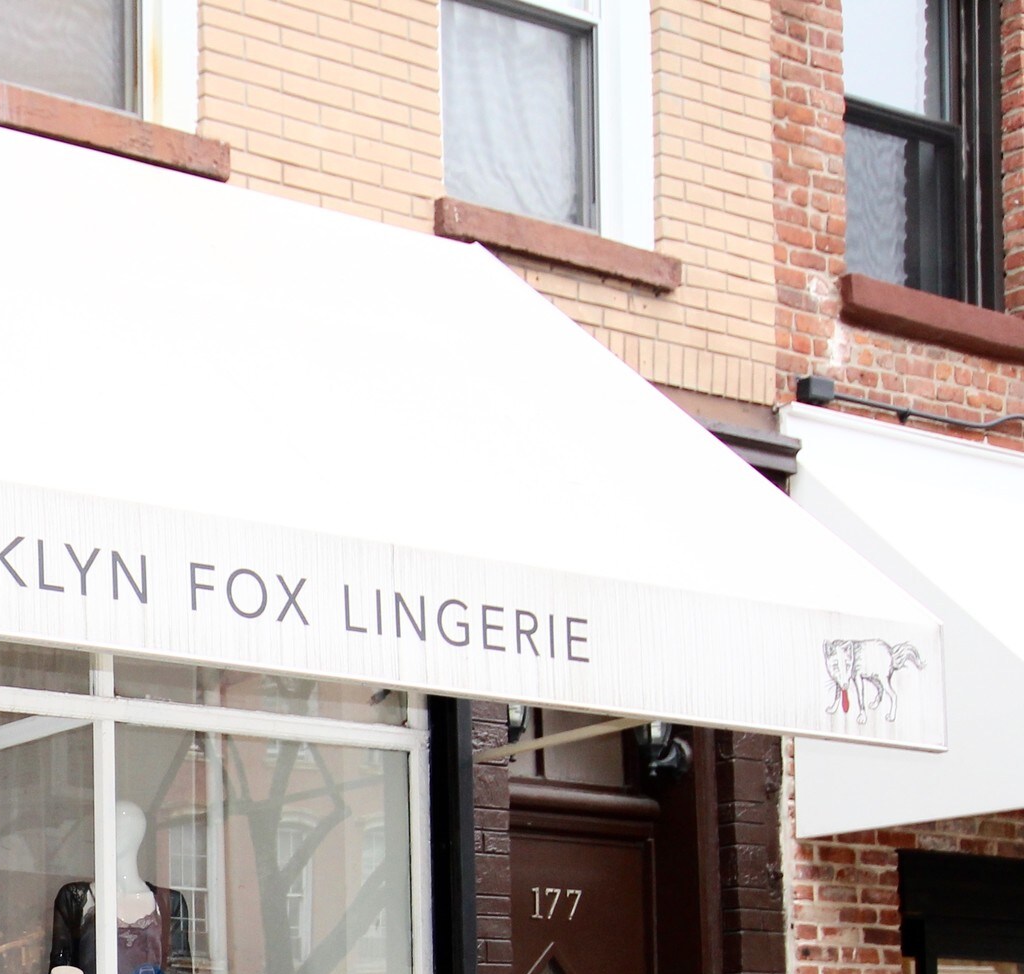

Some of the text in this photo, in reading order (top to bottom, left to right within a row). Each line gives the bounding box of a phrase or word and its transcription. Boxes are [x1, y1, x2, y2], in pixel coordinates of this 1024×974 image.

[189, 562, 310, 626] FOX
[343, 584, 590, 663] LINGERIE
[531, 887, 582, 921] 177
